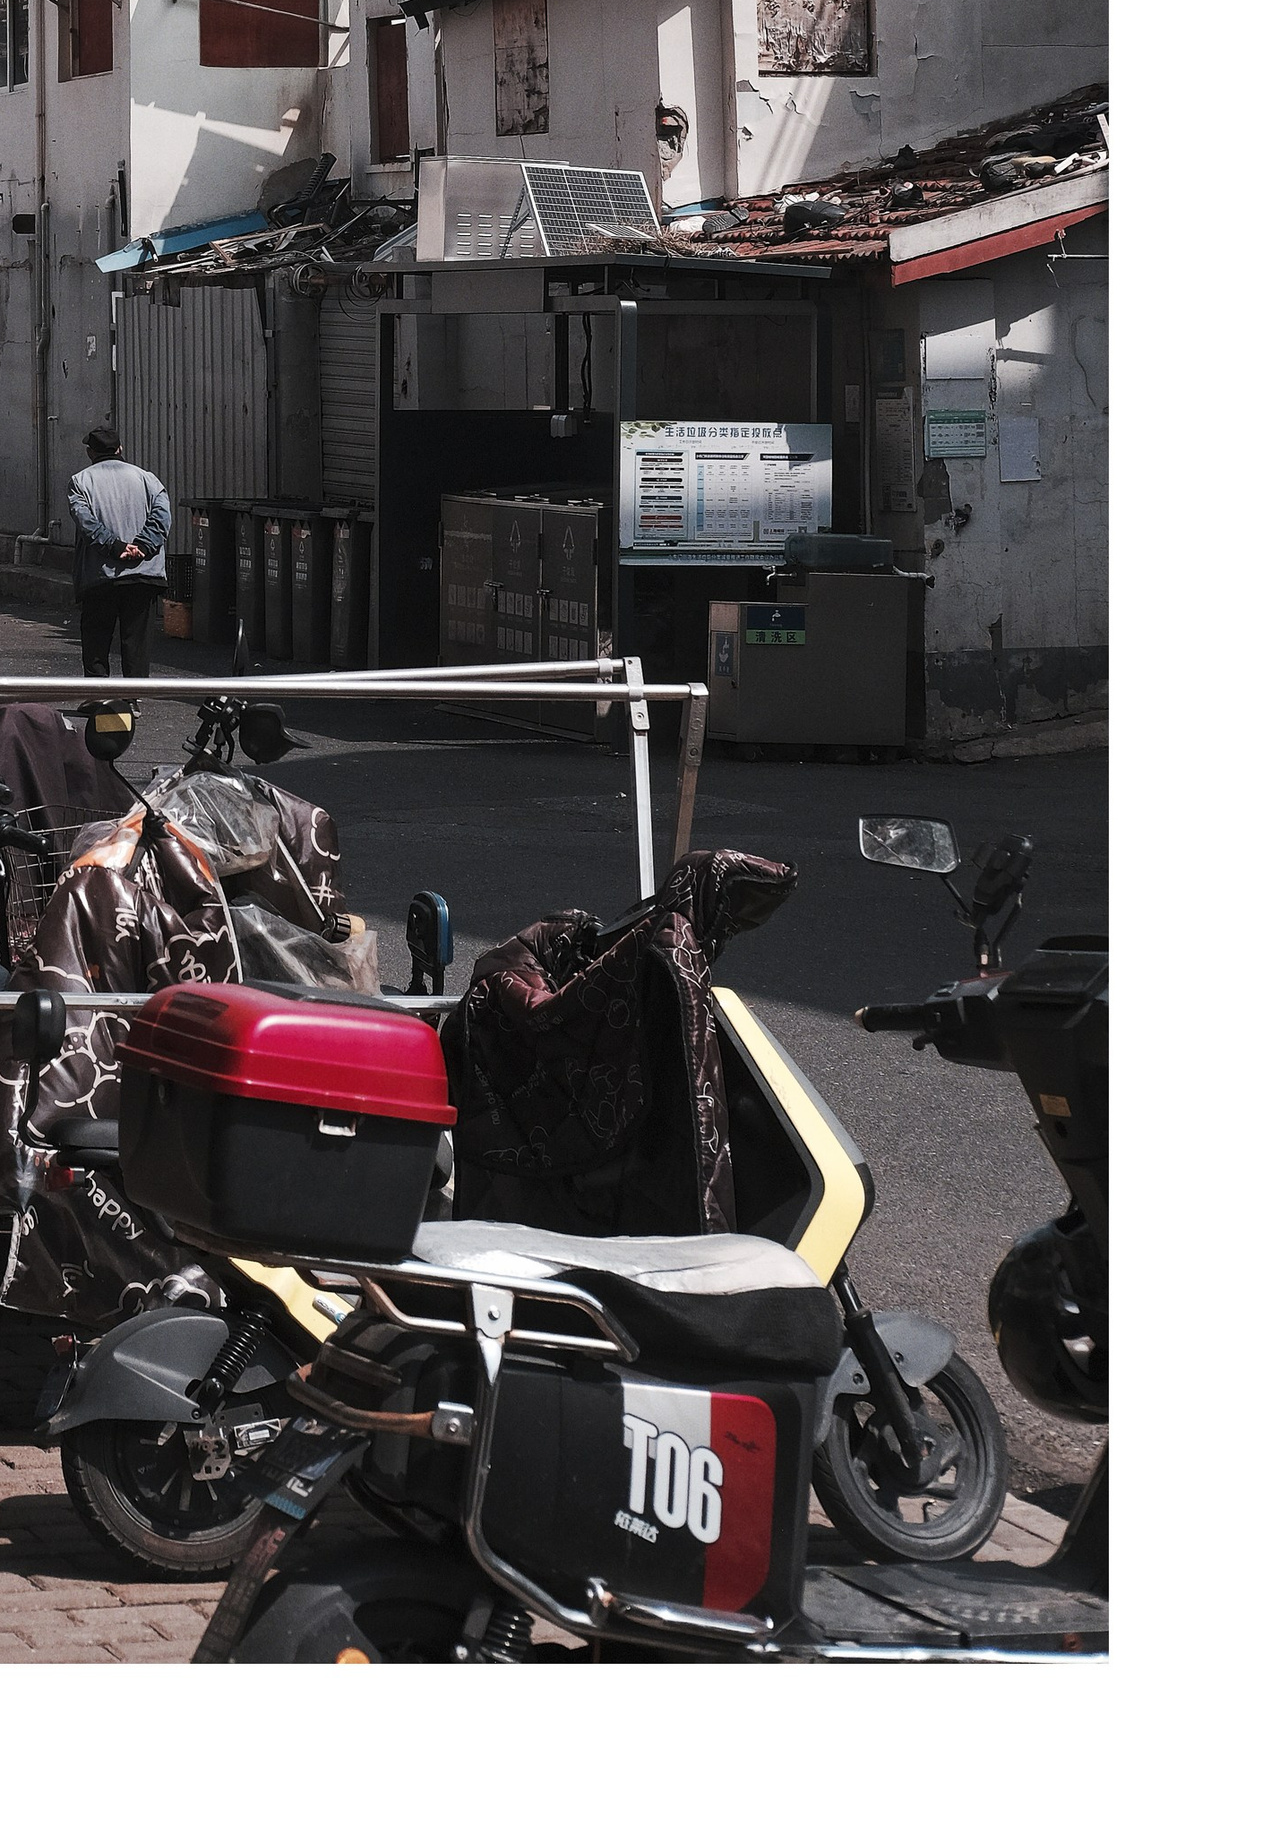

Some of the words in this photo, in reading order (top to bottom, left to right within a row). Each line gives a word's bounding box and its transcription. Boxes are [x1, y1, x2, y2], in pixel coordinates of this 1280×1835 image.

[664, 426, 784, 439] 生活垃圾分类指定投放点
[755, 630, 798, 643] 清洗区
[85, 1169, 144, 1240] happy
[622, 1412, 724, 1544] T06
